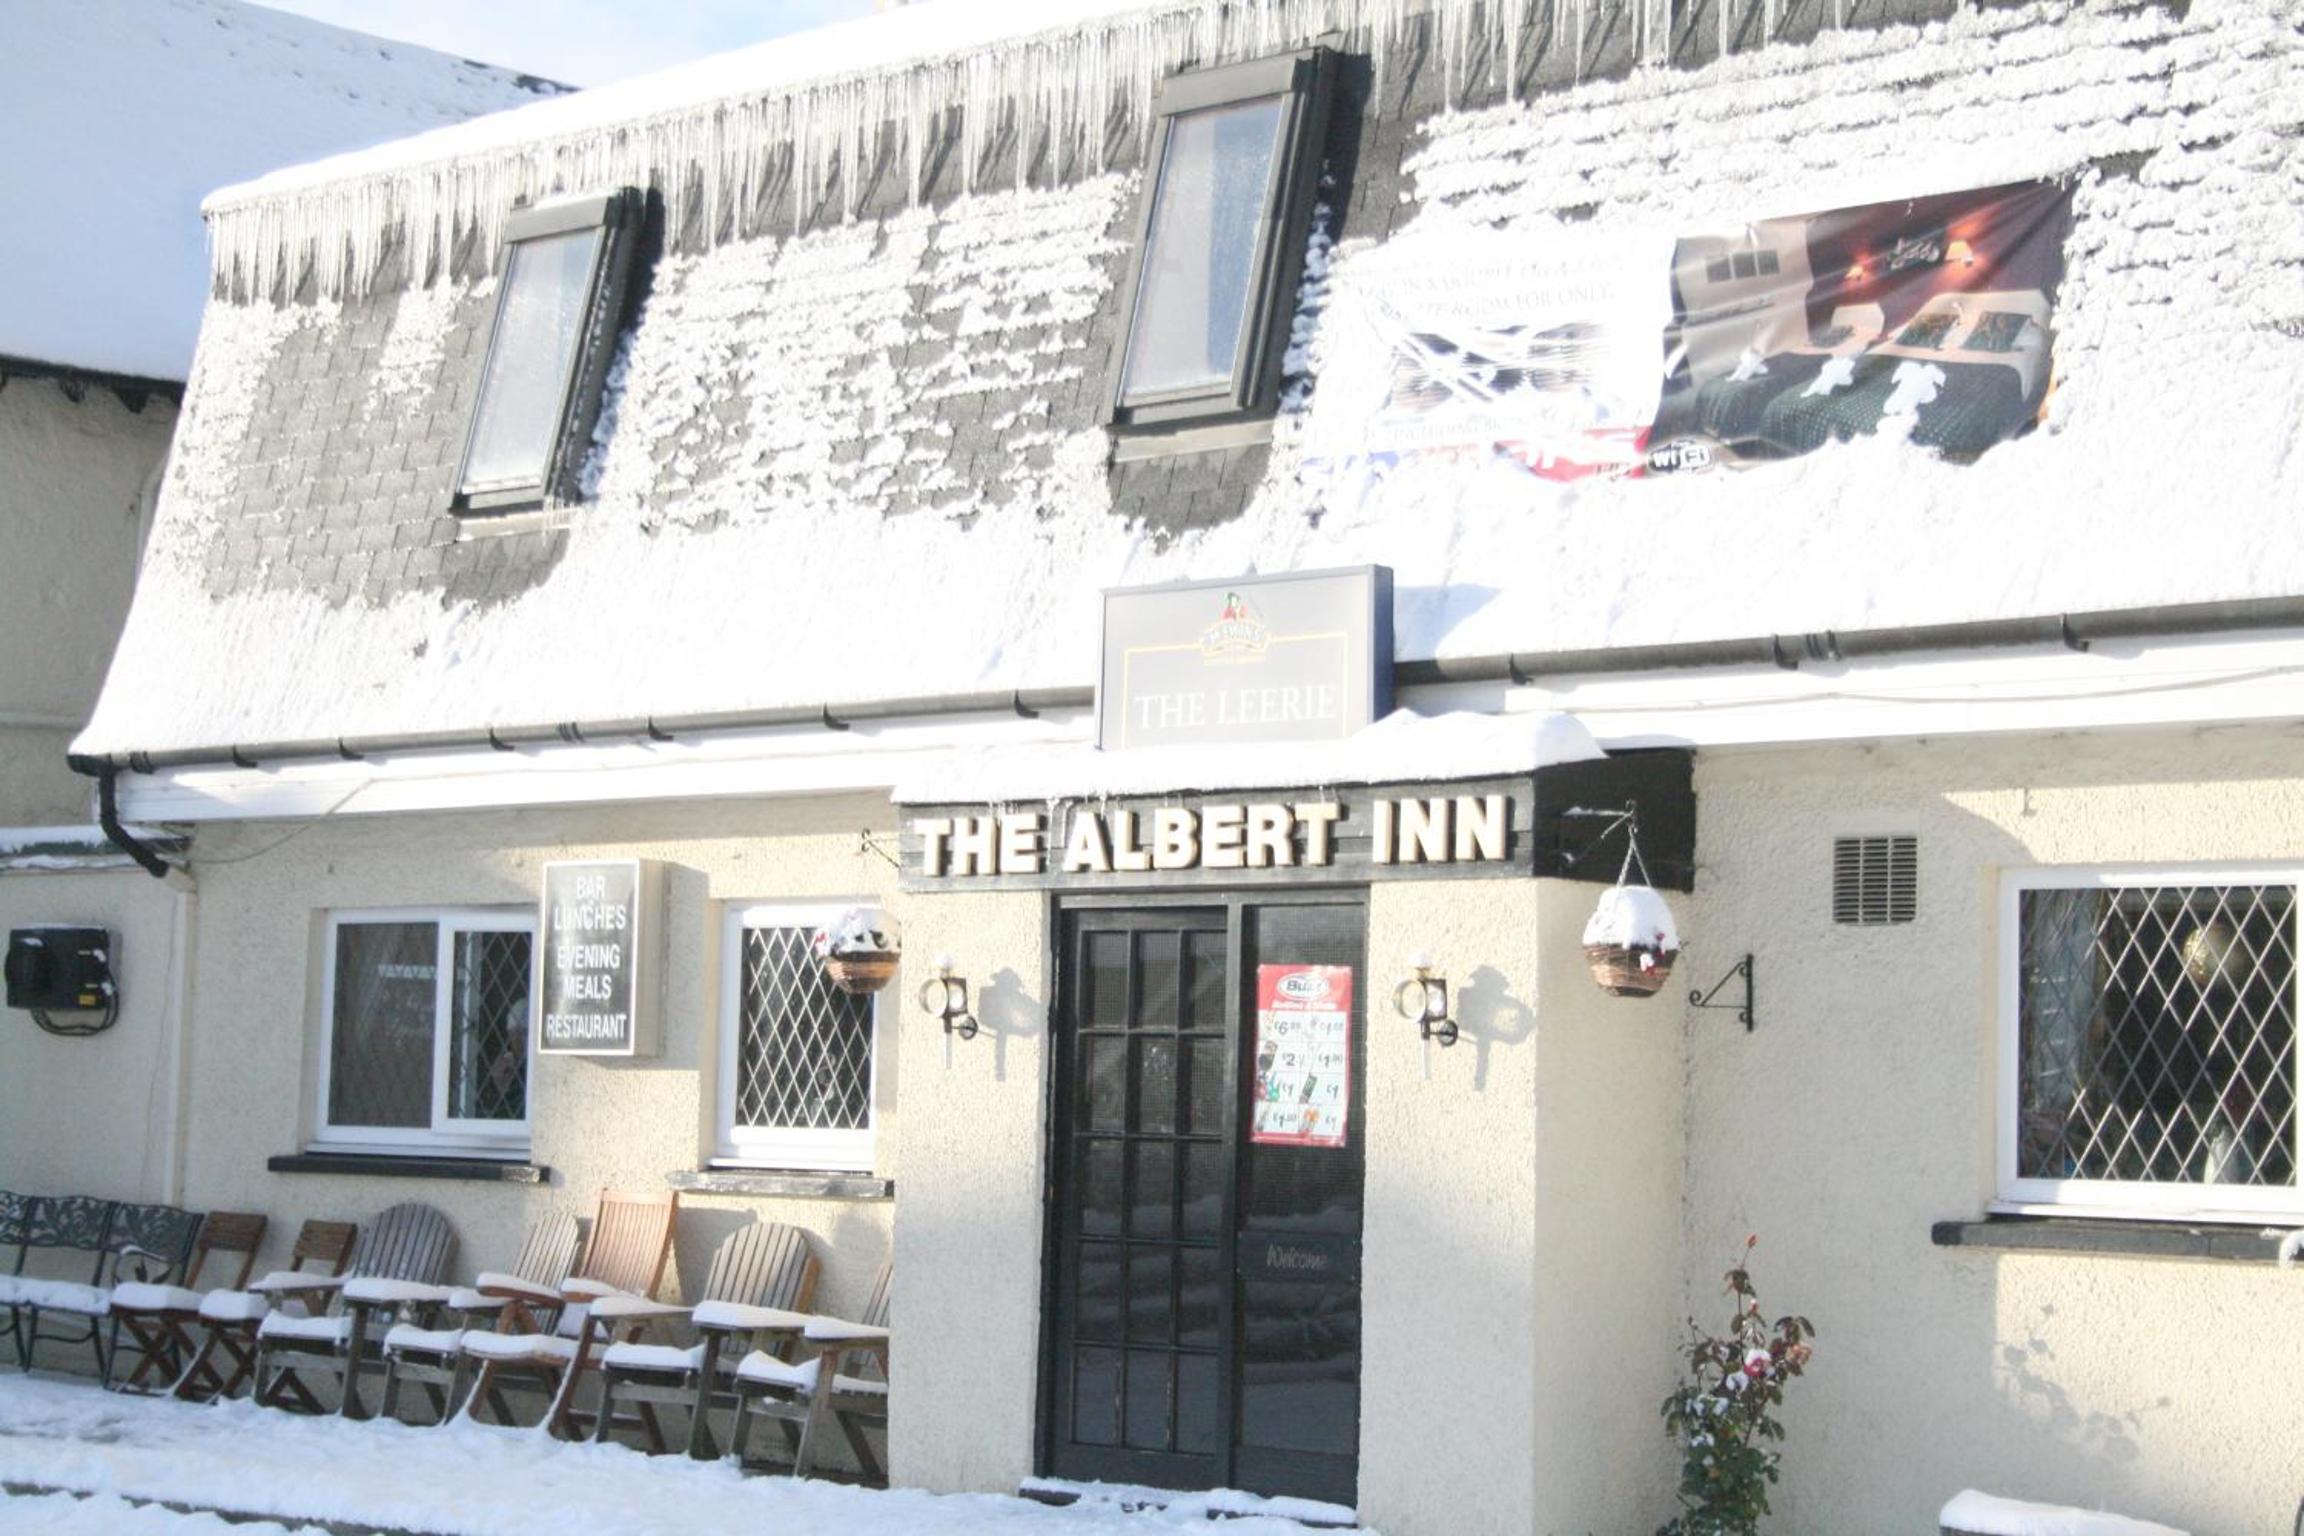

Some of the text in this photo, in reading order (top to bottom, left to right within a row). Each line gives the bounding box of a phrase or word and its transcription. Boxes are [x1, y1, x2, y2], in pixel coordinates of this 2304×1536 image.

[1134, 682, 1338, 730] THE LEERIE
[914, 793, 1508, 877] THE ALBERT INN
[576, 875, 606, 900] BAR
[553, 904, 627, 932] LUNCHES
[556, 943, 621, 970] EVENING
[563, 974, 612, 1000] MEALS
[545, 1013, 627, 1040] RESTAURANT
[1266, 1243, 1329, 1271] Welcome
